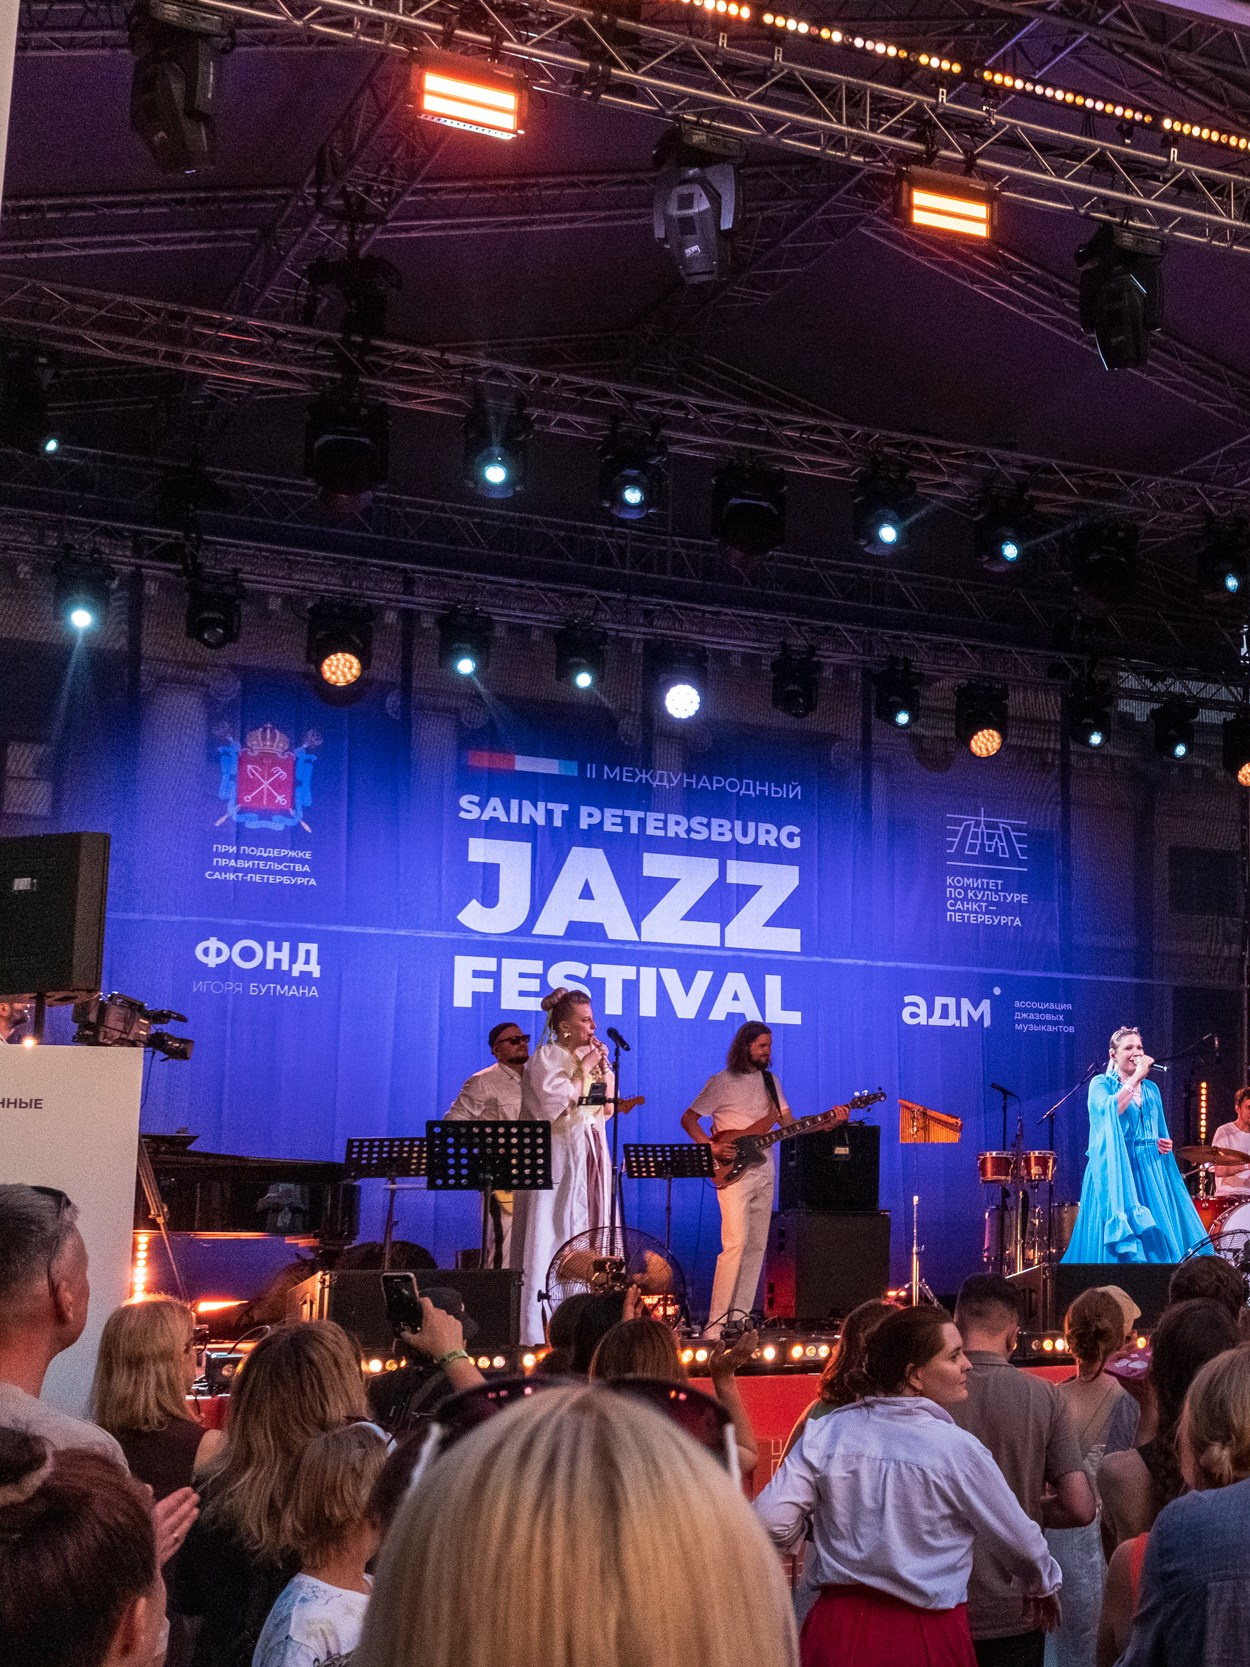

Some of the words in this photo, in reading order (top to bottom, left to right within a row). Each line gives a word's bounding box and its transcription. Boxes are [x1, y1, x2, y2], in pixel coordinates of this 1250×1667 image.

[604, 765, 802, 800] МЕЖДУНАРОДНЫЙ
[458, 795, 569, 828] SAINT
[579, 805, 801, 849] PETERSBURG
[213, 844, 237, 854] ПРИ
[240, 846, 312, 859] ПОДДЕРЖКЕ
[213, 858, 311, 872] ПРАВИТЕЛЬСТВА
[205, 871, 317, 886] САНКТ-ПЕТЕРБУРГА
[946, 876, 1003, 890] КОМИТЕТ
[456, 837, 801, 952] JAZZ
[946, 888, 964, 898] ПО
[968, 890, 1028, 904] КУЛЬТУРЕ
[946, 912, 1022, 927] ПЕТЕРБУРГА
[195, 937, 321, 978] ФОНД
[193, 981, 243, 994] ИГОРЯ
[250, 984, 319, 998] БУТМАНА
[453, 955, 802, 1025] FESTIVAL
[1014, 1001, 1072, 1011] ассоциация
[1014, 1012, 1064, 1022] джазовых
[1015, 1023, 1075, 1033] музыкантов
